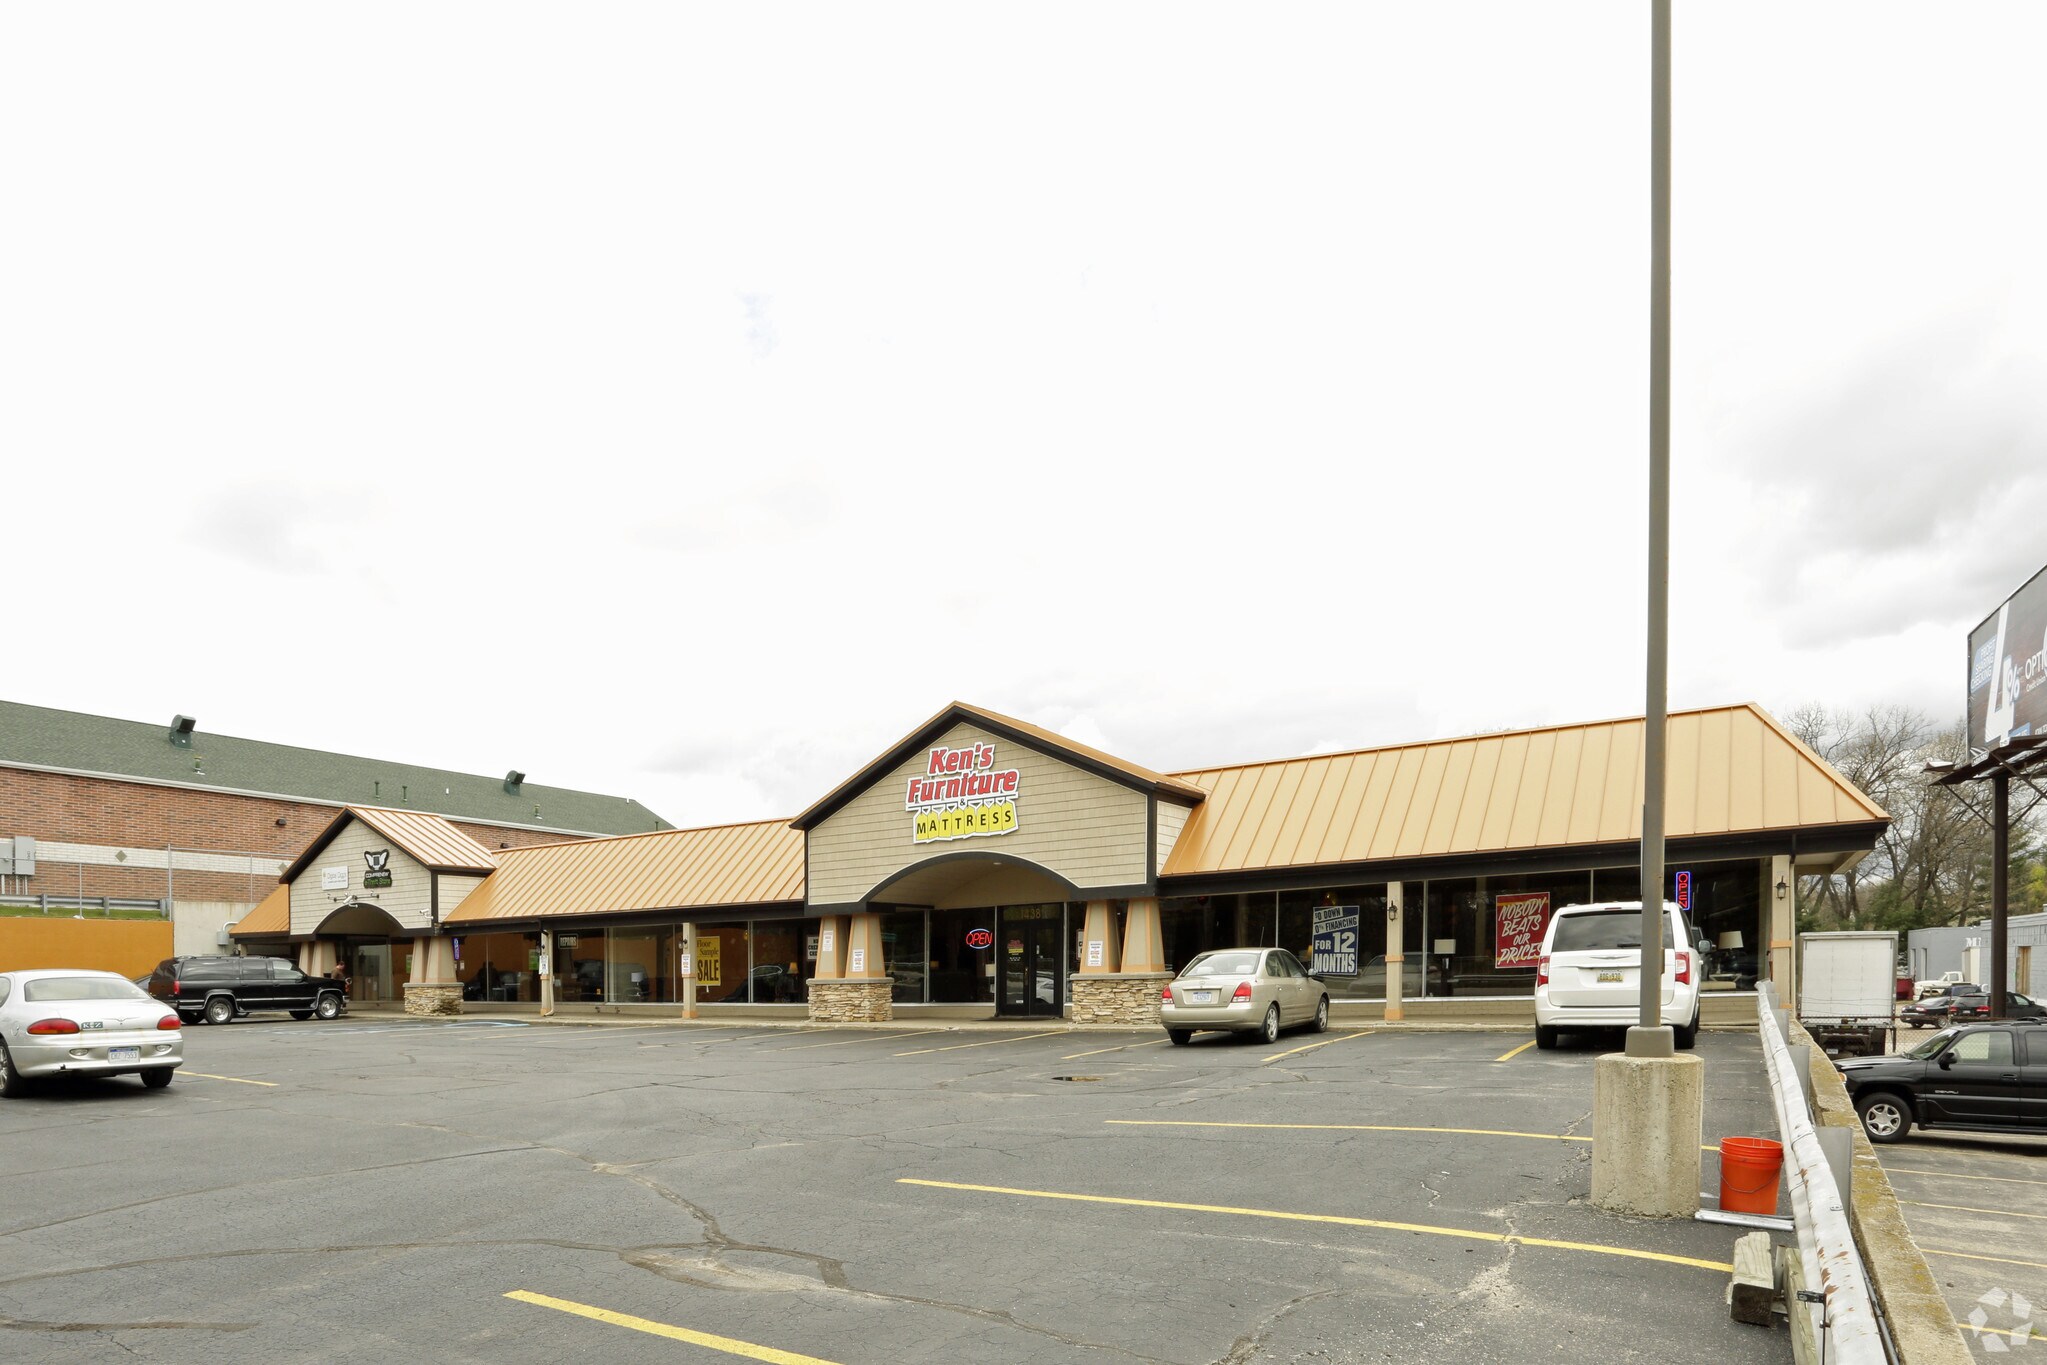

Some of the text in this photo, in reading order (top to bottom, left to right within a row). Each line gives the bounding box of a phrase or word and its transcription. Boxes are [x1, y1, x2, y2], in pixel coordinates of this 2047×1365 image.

[928, 743, 993, 774] Ken's
[907, 770, 1018, 803] Furniture
[960, 798, 965, 806] &
[916, 810, 1012, 835] MATTRESS
[1678, 873, 1688, 908] OPEN
[1323, 907, 1340, 919] DOWN
[1498, 896, 1547, 921] NOBODY
[1325, 916, 1357, 931] FINANCING
[1501, 914, 1542, 937] BEATS
[966, 932, 992, 945] OPEN
[1314, 931, 1355, 953] FOR 12
[1513, 933, 1531, 945] OUR
[697, 959, 719, 981] SALE
[1314, 953, 1355, 973] MONTHS
